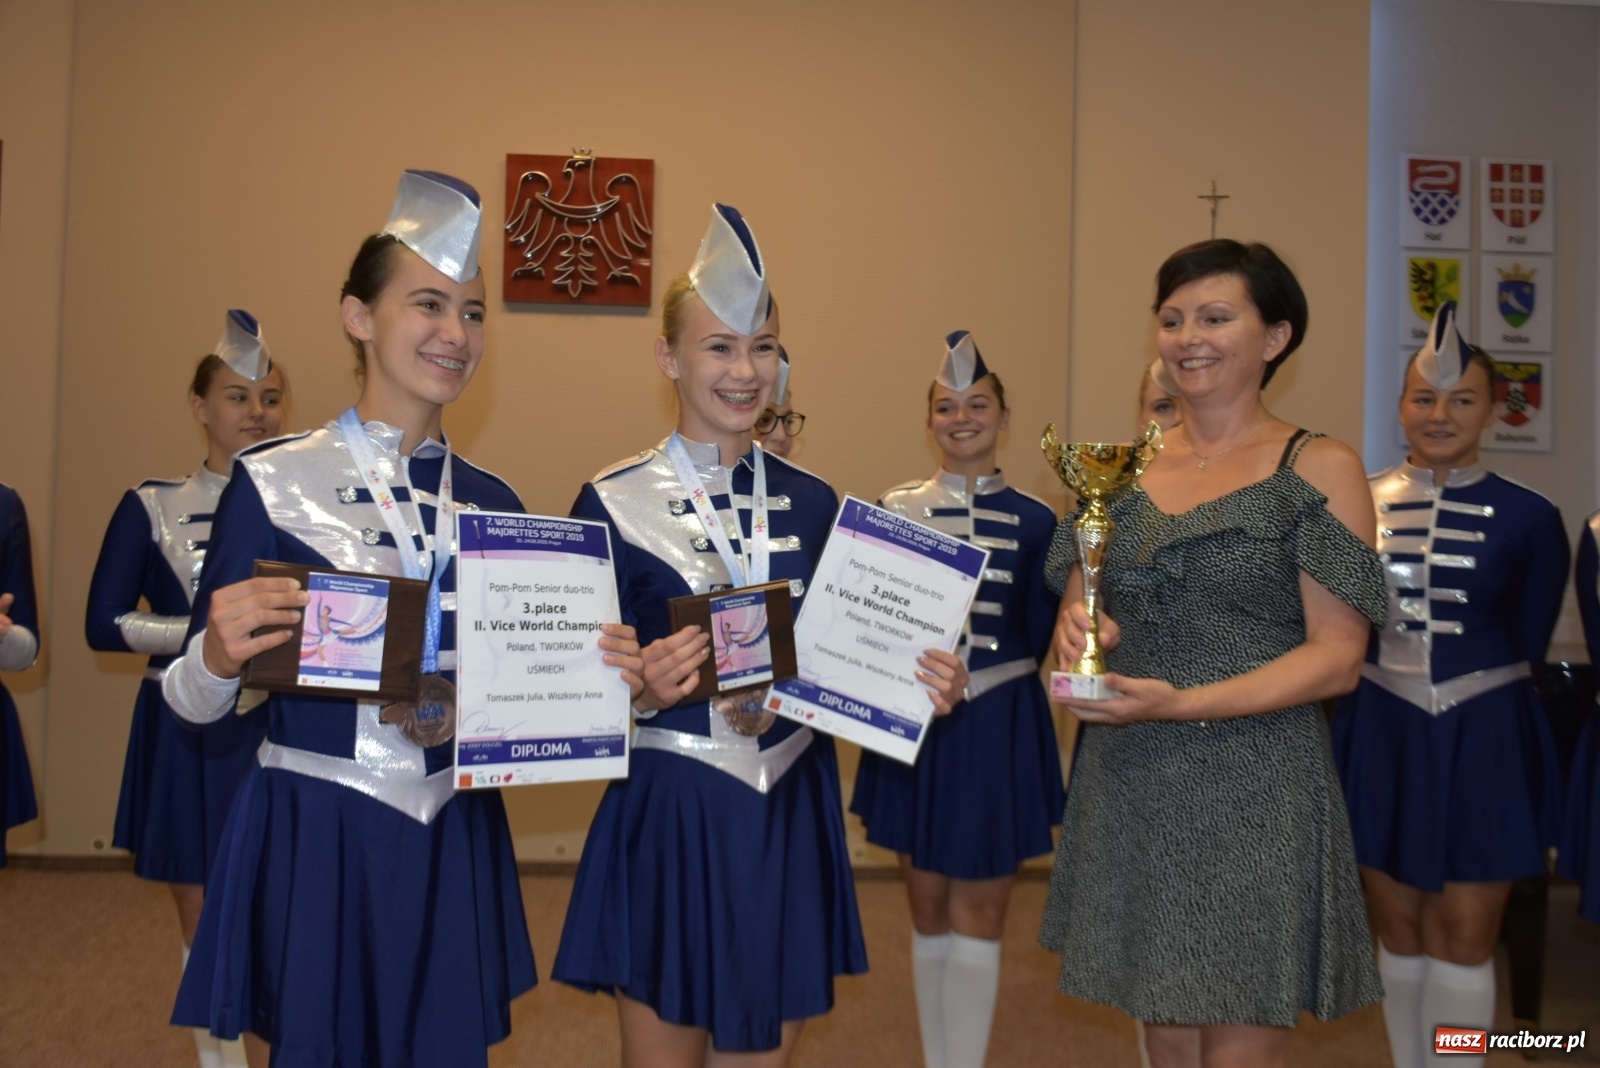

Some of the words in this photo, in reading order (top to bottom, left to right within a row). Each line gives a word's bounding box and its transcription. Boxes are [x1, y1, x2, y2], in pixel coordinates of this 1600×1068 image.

[486, 517, 493, 526] 7.
[494, 518, 525, 527] WORLD
[527, 520, 583, 532] CHAMPIONSHIP
[876, 510, 904, 526] WORLD
[904, 521, 960, 548] CHAMPIONSHIP
[487, 527, 539, 537] MAJORETTES
[540, 530, 564, 539] SPORT
[566, 532, 584, 541] 2019
[866, 514, 912, 538] MAJORETTES
[914, 533, 937, 548] SPORT
[938, 542, 958, 556] 2019
[849, 558, 886, 579] Pom-Pom
[888, 573, 912, 589] Senior
[914, 584, 945, 601] duo-trio
[489, 583, 532, 594] Pom-Pom
[534, 584, 561, 593] Senior
[564, 585, 594, 594] duo-trio
[871, 585, 910, 607] 3.place
[523, 603, 567, 615] 3.place
[825, 583, 835, 594] II.
[839, 588, 860, 604] Vice
[863, 597, 894, 616] World
[895, 610, 945, 636] Champion
[474, 620, 486, 631] II.
[490, 620, 516, 631] Vice
[520, 620, 553, 631] World
[845, 610, 872, 627] Poland,
[874, 621, 914, 642] TWORKÓW
[507, 643, 537, 652] Poland,
[540, 641, 583, 651] TWORKÓW
[856, 635, 890, 653] UŚMIECH
[528, 664, 565, 674] UŚMIECH
[814, 643, 847, 661] Tomaszek
[865, 662, 896, 680] Wiszkony
[897, 675, 914, 686] Anna
[486, 693, 524, 702] Tomaszek
[527, 693, 545, 702] Julia,
[548, 692, 582, 701] Wiszkony
[818, 690, 871, 721] DIPLOMA
[511, 742, 572, 758] DIPLOMA
